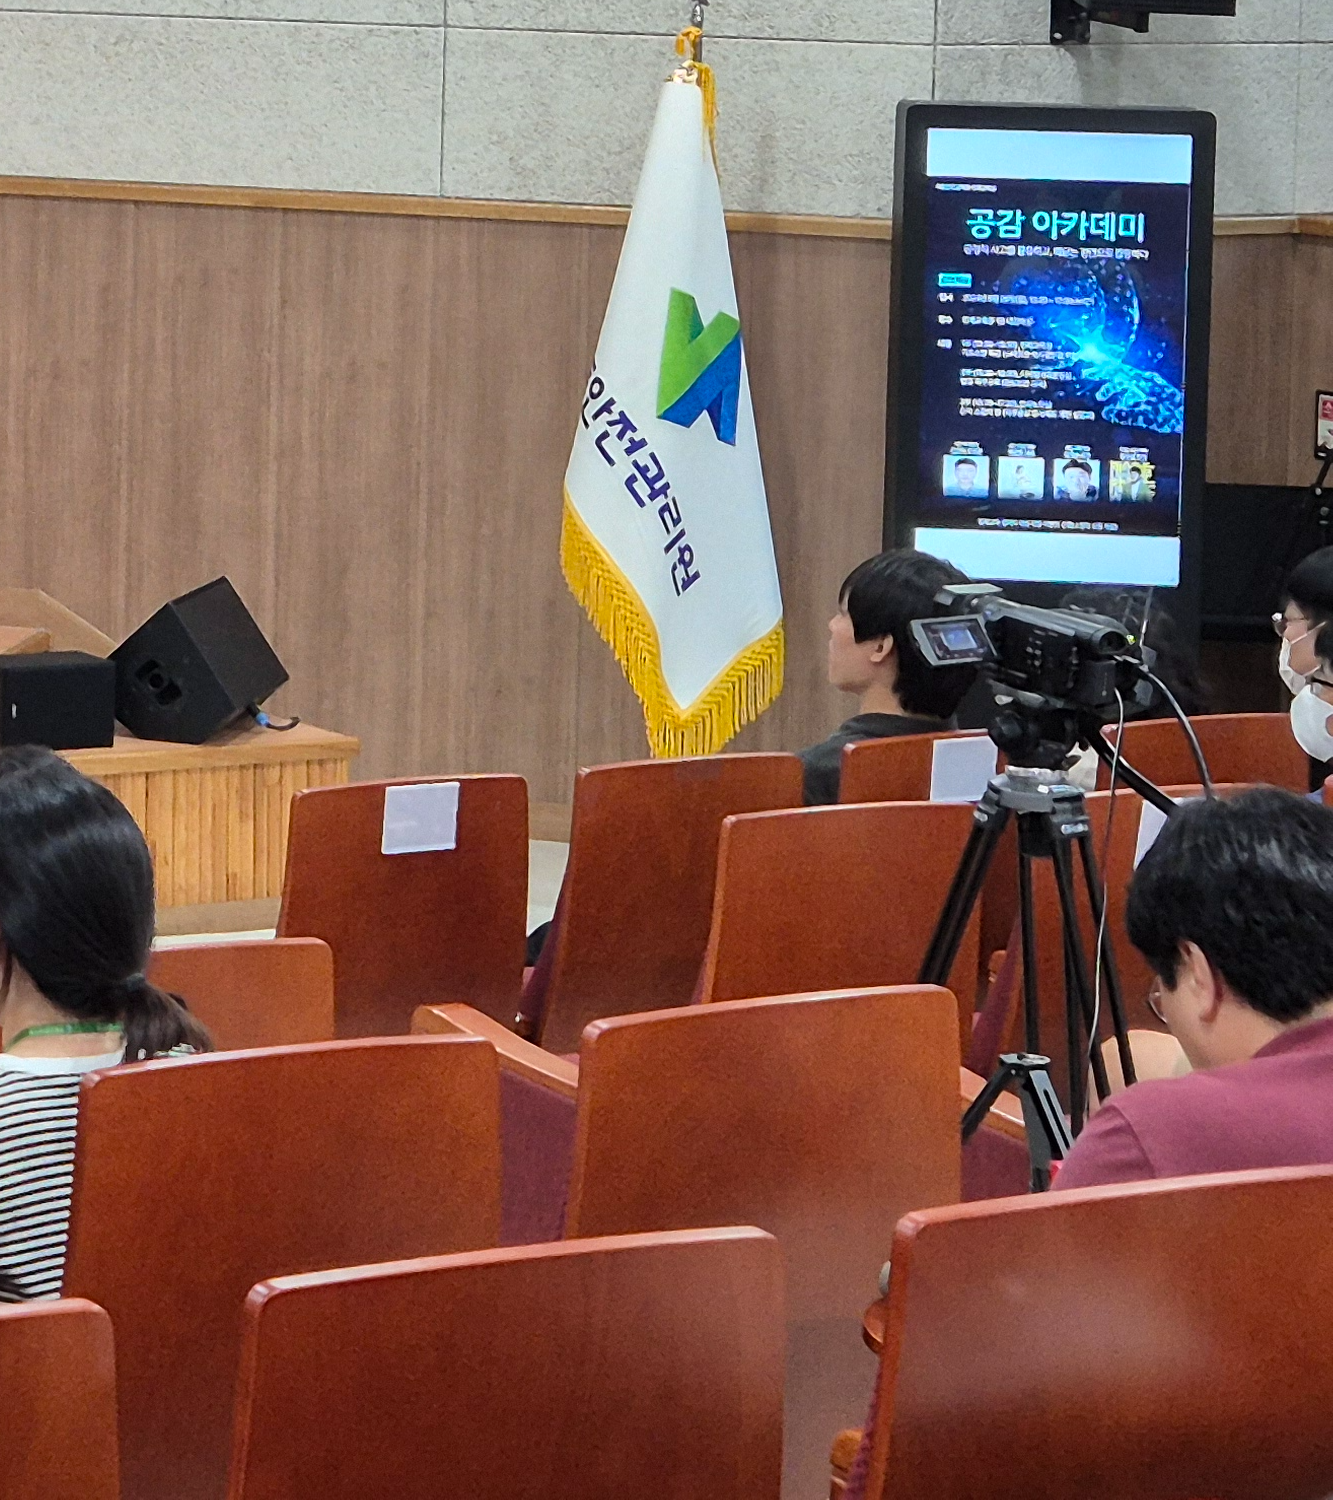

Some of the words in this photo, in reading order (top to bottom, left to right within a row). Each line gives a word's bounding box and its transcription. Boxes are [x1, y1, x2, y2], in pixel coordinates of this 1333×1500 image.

[965, 207, 1026, 240] 공감
[1031, 209, 1146, 244] 아카데미
[582, 360, 701, 598] 안전관리원
